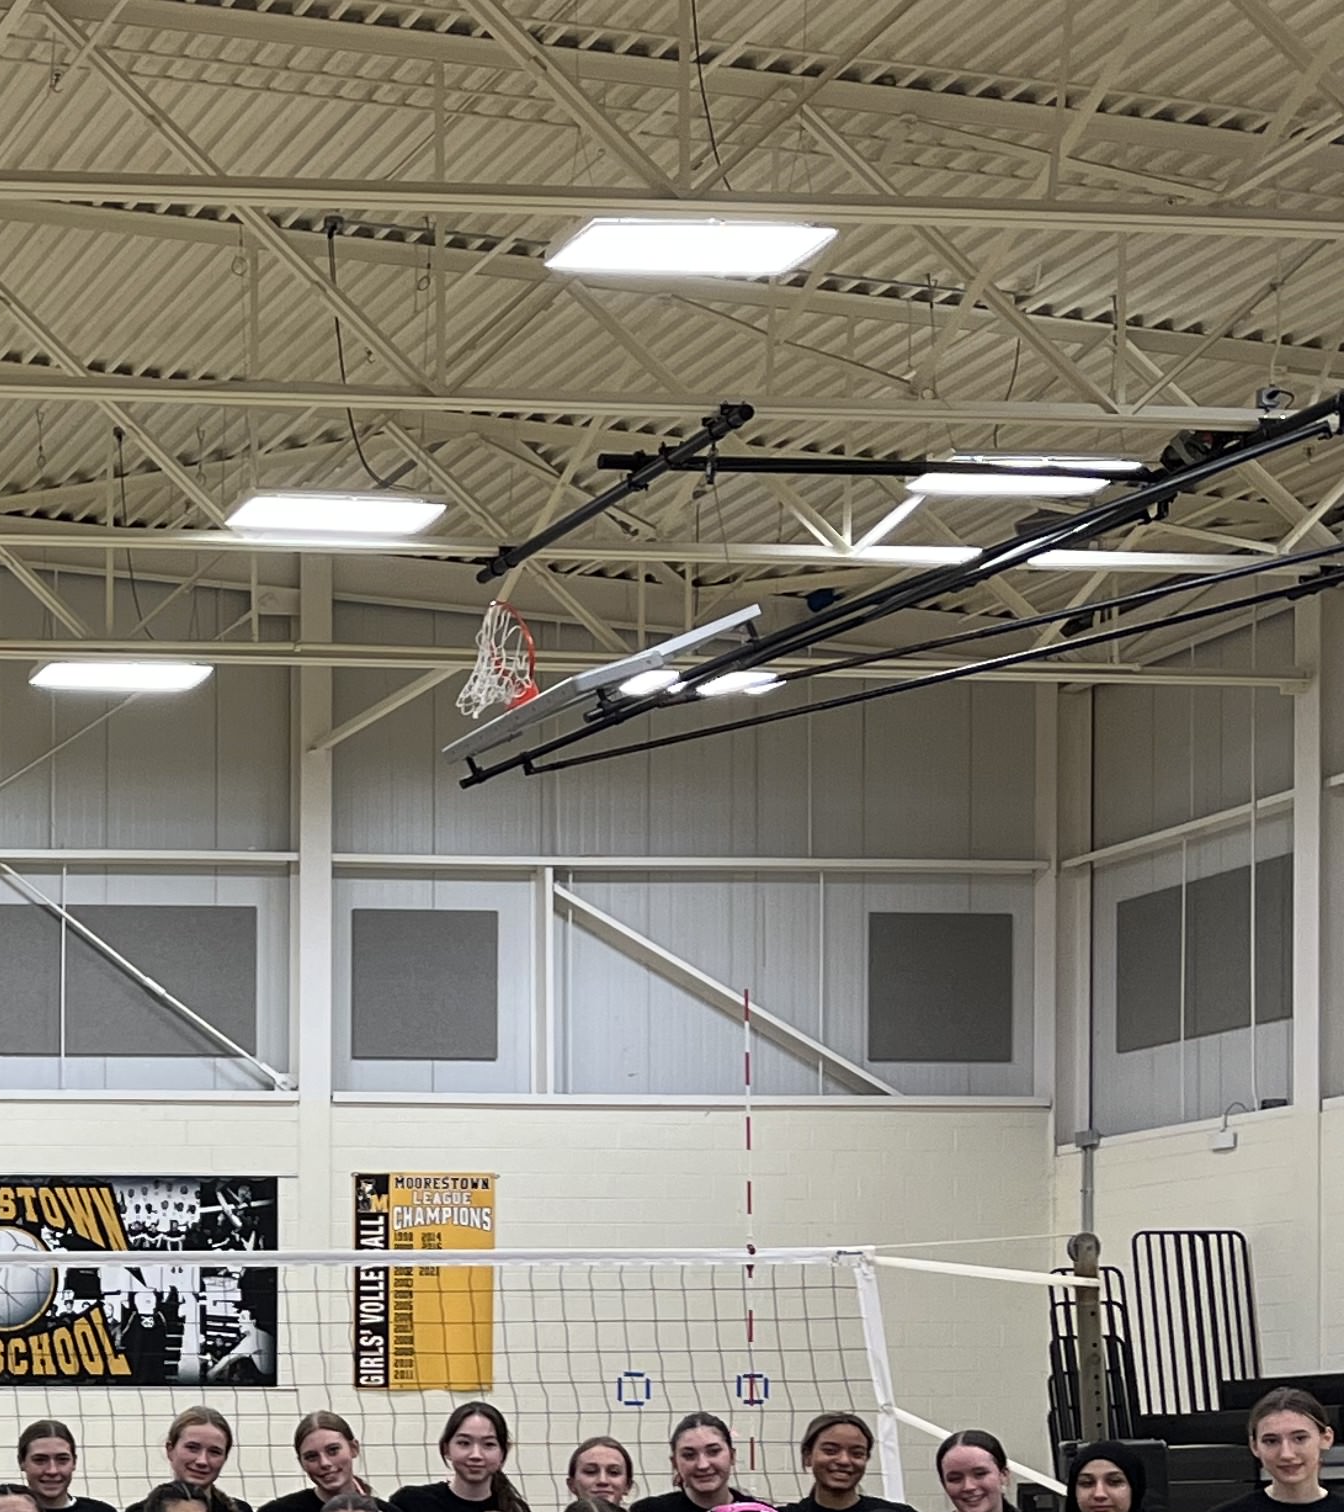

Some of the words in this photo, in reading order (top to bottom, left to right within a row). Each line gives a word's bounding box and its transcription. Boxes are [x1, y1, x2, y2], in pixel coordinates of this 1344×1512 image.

[395, 1176, 490, 1190] MOORESTOWN
[413, 1191, 472, 1205] LEAGUE
[392, 1206, 493, 1232] CHAMPIONS
[359, 1329, 385, 1386] GIRLS'
